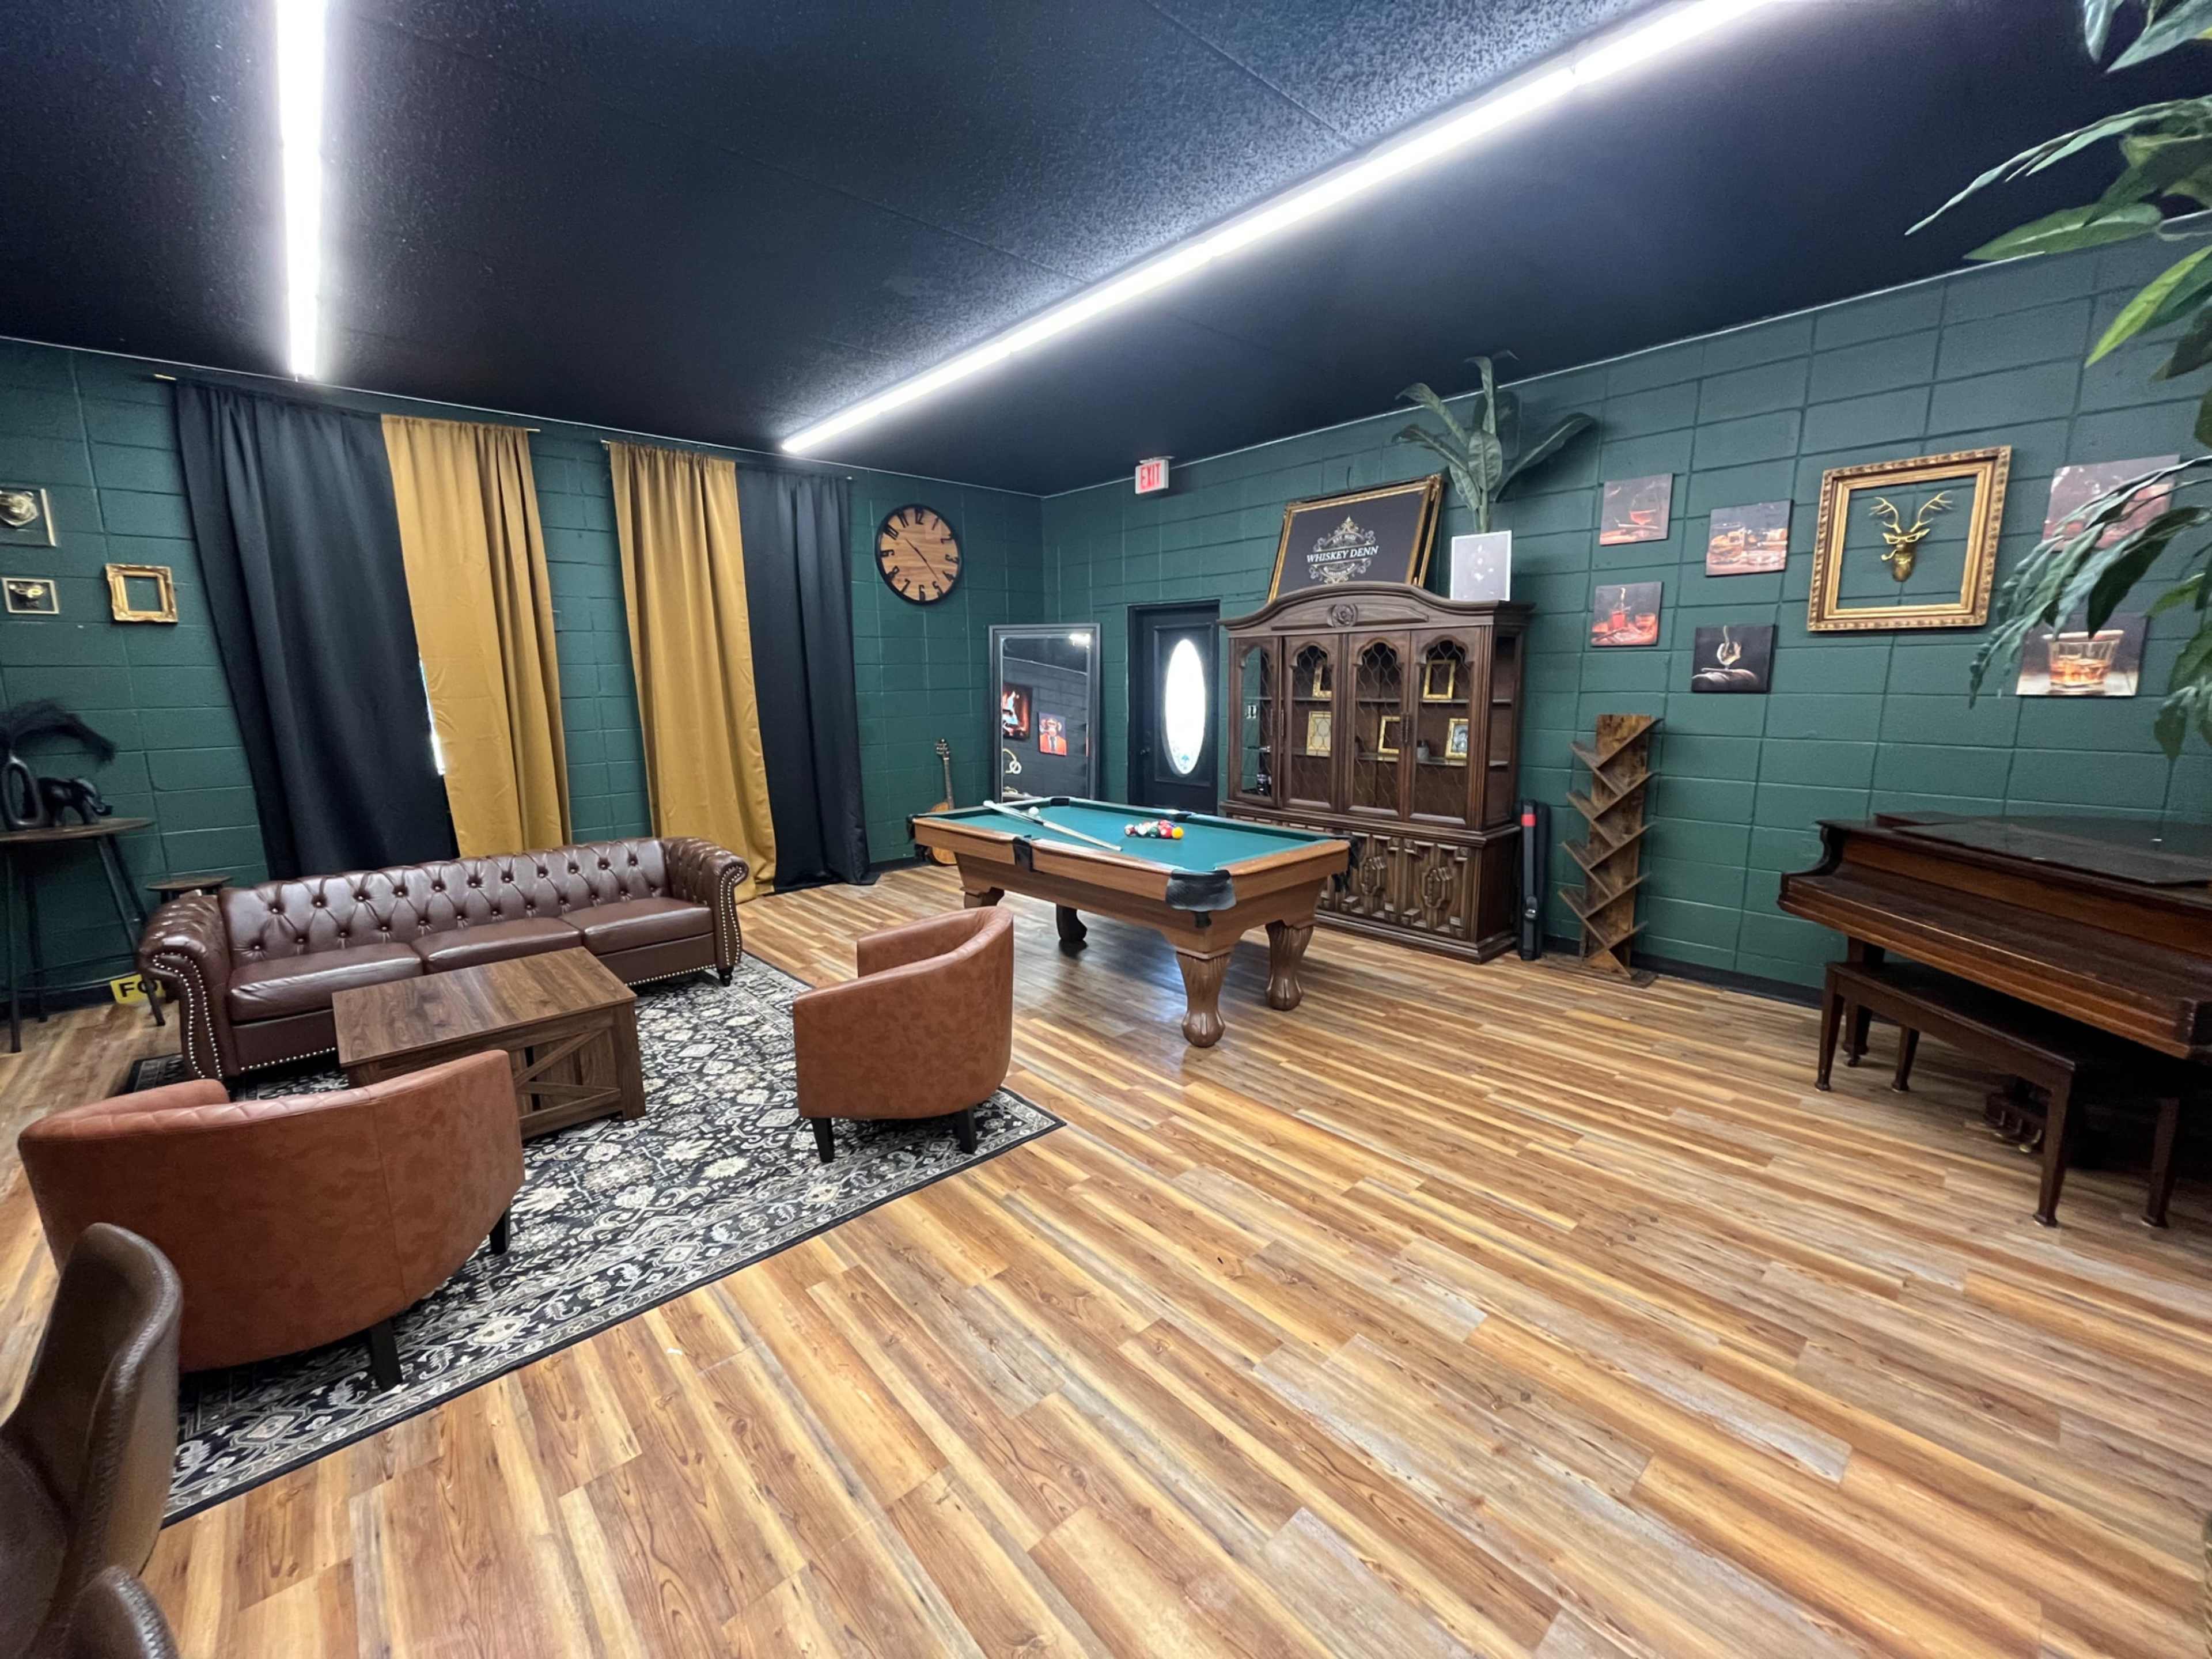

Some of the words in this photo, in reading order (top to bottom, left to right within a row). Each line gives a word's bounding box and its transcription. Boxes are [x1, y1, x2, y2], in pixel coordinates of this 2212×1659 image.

[1141, 463, 1161, 490] EXIT
[897, 510, 909, 528] 11
[914, 507, 925, 525] 12
[884, 523, 899, 540] 10
[940, 533, 952, 544] 2
[880, 549, 895, 558] 9
[945, 554, 960, 565] 3
[1306, 550, 1349, 563] WHISKEY
[1350, 545, 1379, 558] DENN
[886, 566, 900, 579] 8
[942, 570, 955, 582] 4
[900, 578, 911, 593] 7
[919, 584, 926, 601] 6
[932, 581, 944, 597] 5
[119, 978, 167, 997] FO
